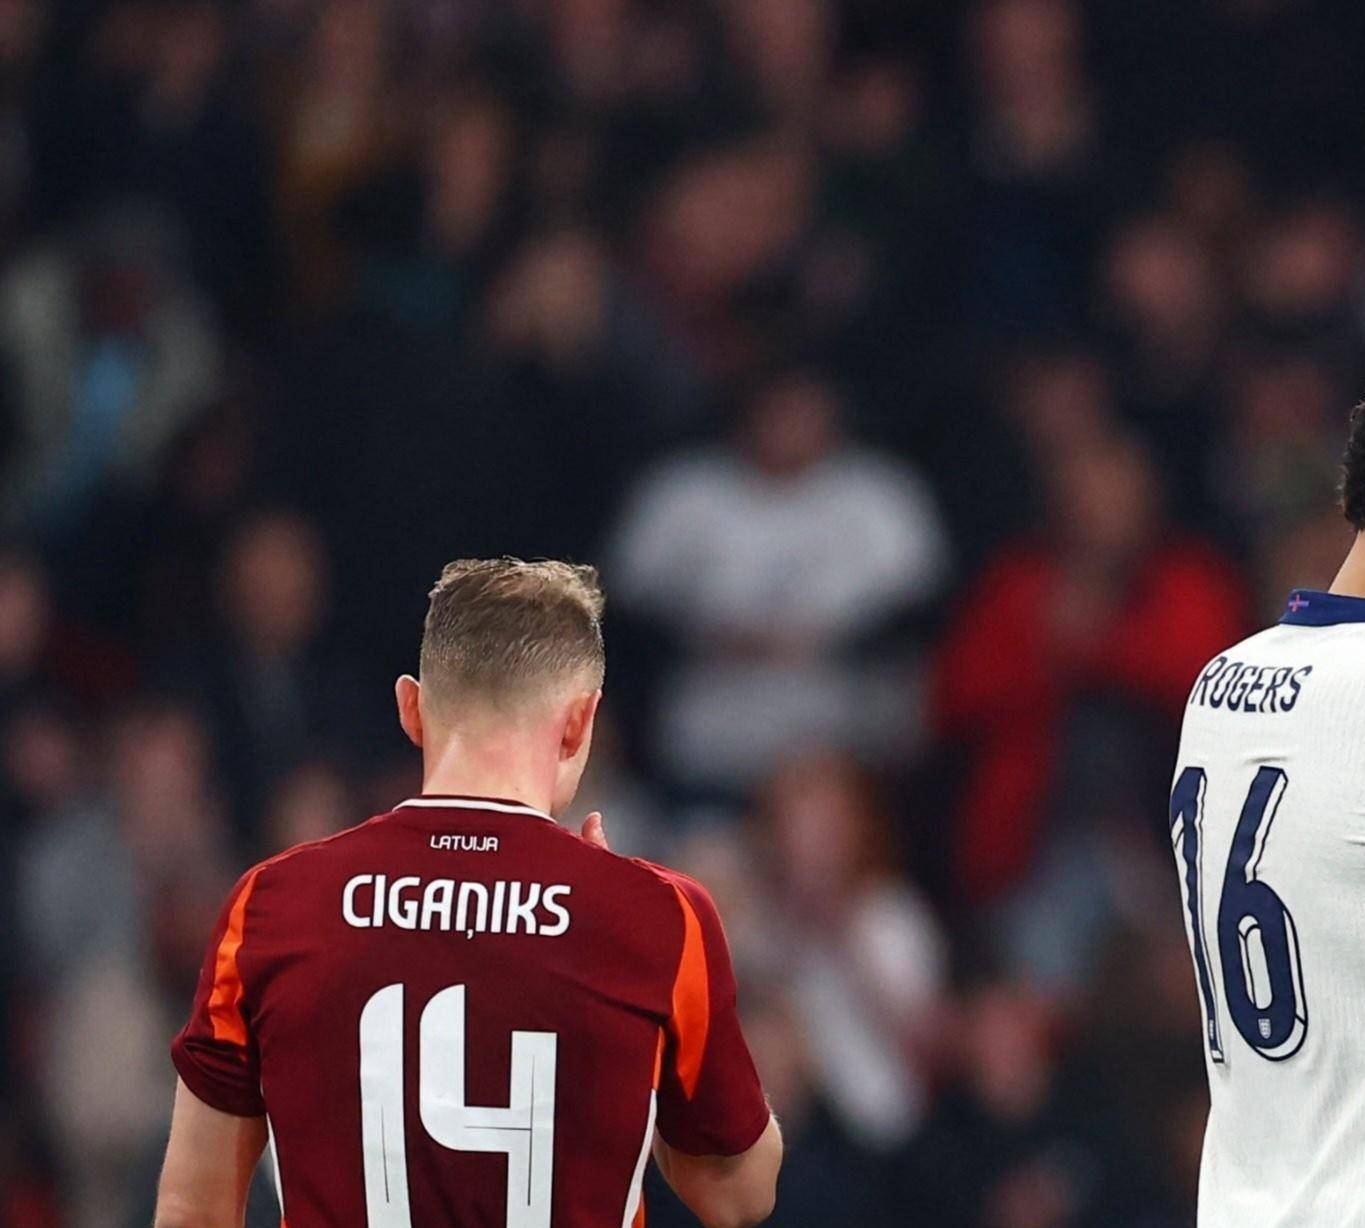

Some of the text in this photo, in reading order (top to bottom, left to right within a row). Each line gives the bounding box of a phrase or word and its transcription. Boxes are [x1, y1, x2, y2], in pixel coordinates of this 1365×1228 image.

[1190, 655, 1313, 713] ROGERS
[430, 835, 499, 852] LATVIJA
[342, 873, 572, 940] CIGAŅIKS
[1169, 765, 1309, 1063] 16
